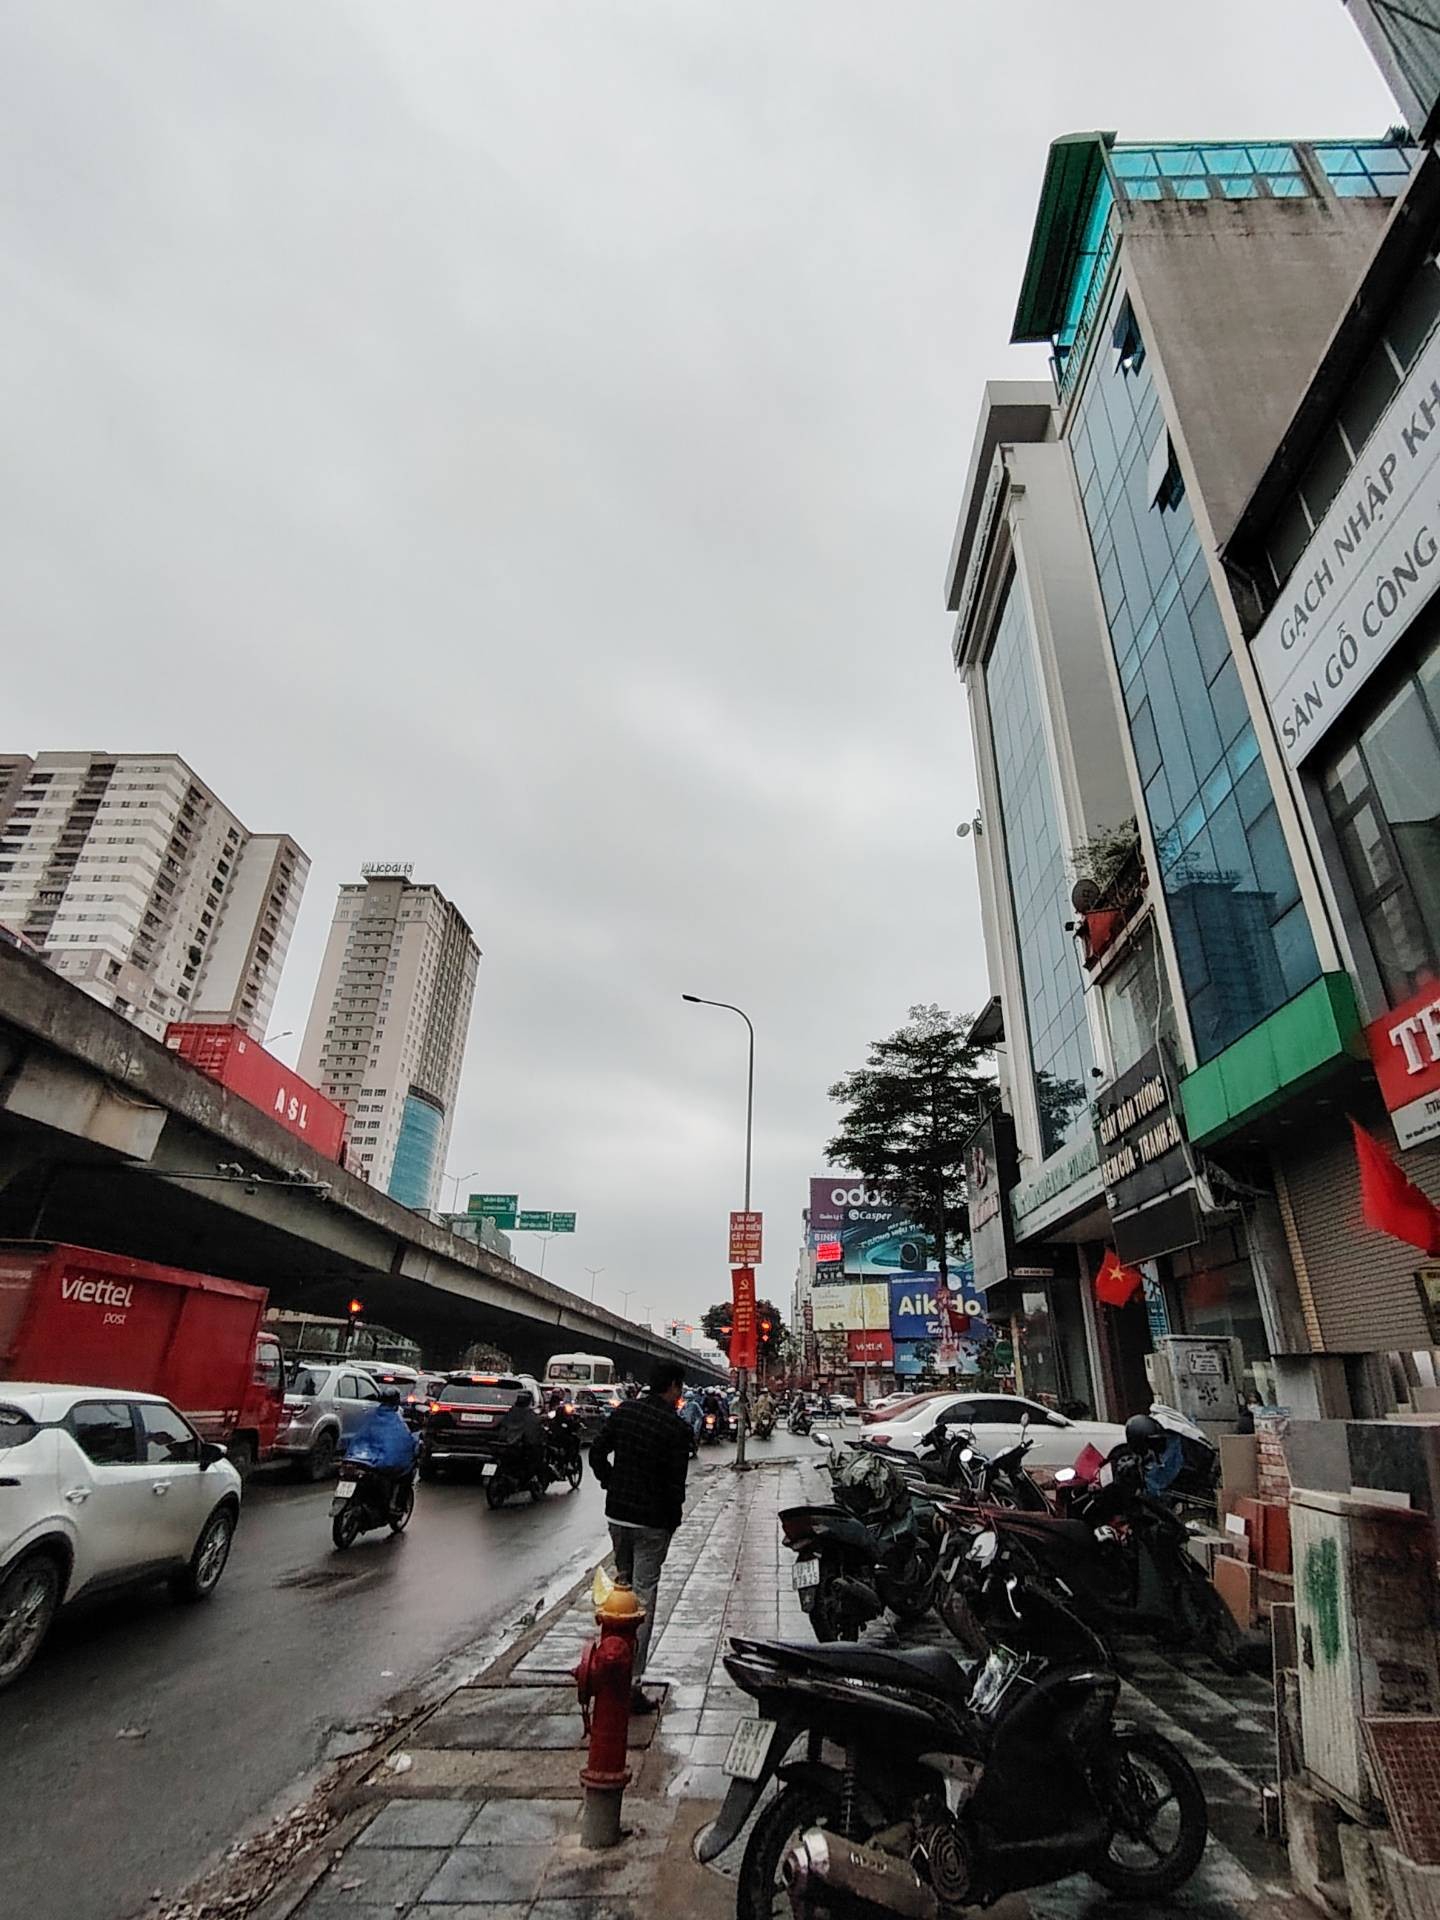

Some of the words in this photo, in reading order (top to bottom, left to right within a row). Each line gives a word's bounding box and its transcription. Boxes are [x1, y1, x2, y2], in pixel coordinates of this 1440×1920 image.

[1280, 558, 1333, 650] GẠCH
[1333, 453, 1397, 566] NHẬP
[1325, 621, 1358, 689] GỖ
[1362, 526, 1439, 638] CÔNG
[371, 864, 401, 873] LICOGI
[1139, 1121, 1170, 1164] TRANH
[860, 1211, 892, 1222] Casper
[62, 1276, 134, 1307] viettel
[898, 1292, 981, 1317] Aikdo
[103, 1312, 126, 1325] post
